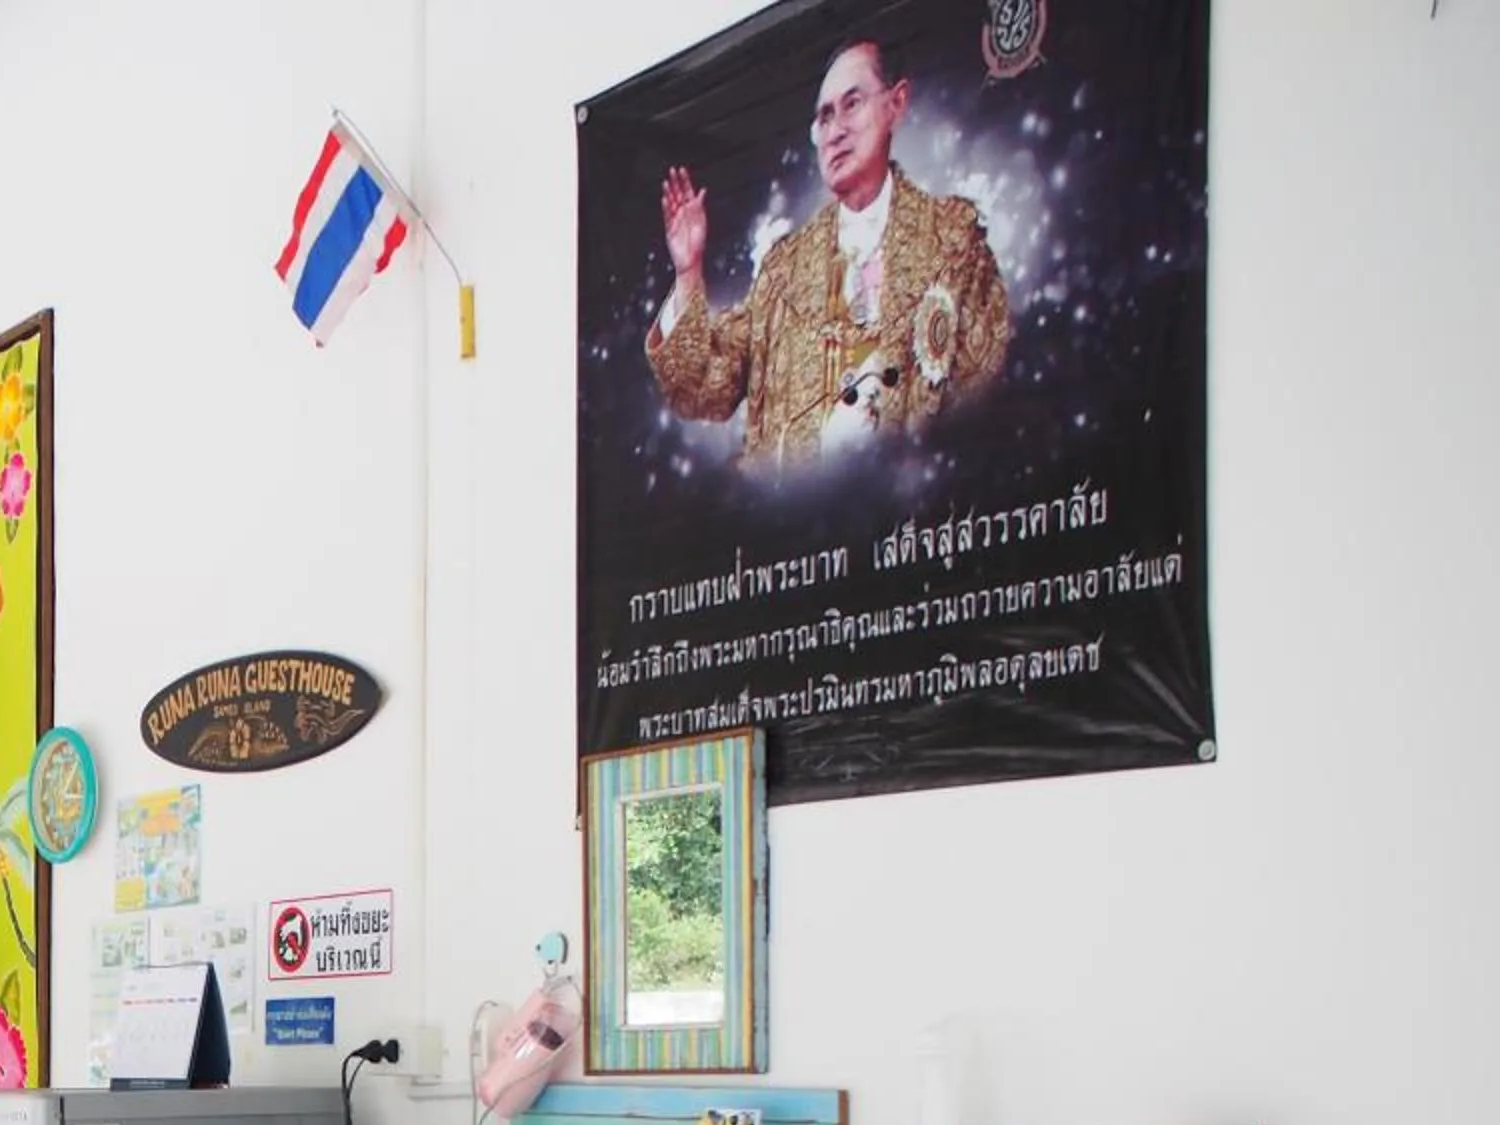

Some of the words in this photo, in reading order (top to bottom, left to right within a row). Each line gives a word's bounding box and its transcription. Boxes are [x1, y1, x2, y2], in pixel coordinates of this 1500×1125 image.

[629, 545, 849, 624] กราบแทบฝ่าพระบาท
[873, 477, 1108, 571] เสด็จสู่สวรรคาลัย
[147, 683, 195, 746] RUNA
[197, 665, 241, 706] RUNA
[245, 658, 356, 705] GUESTHOUSE
[311, 901, 389, 938] ห้ามทิ้งขยะ
[316, 936, 383, 973] บริเวณนี้
